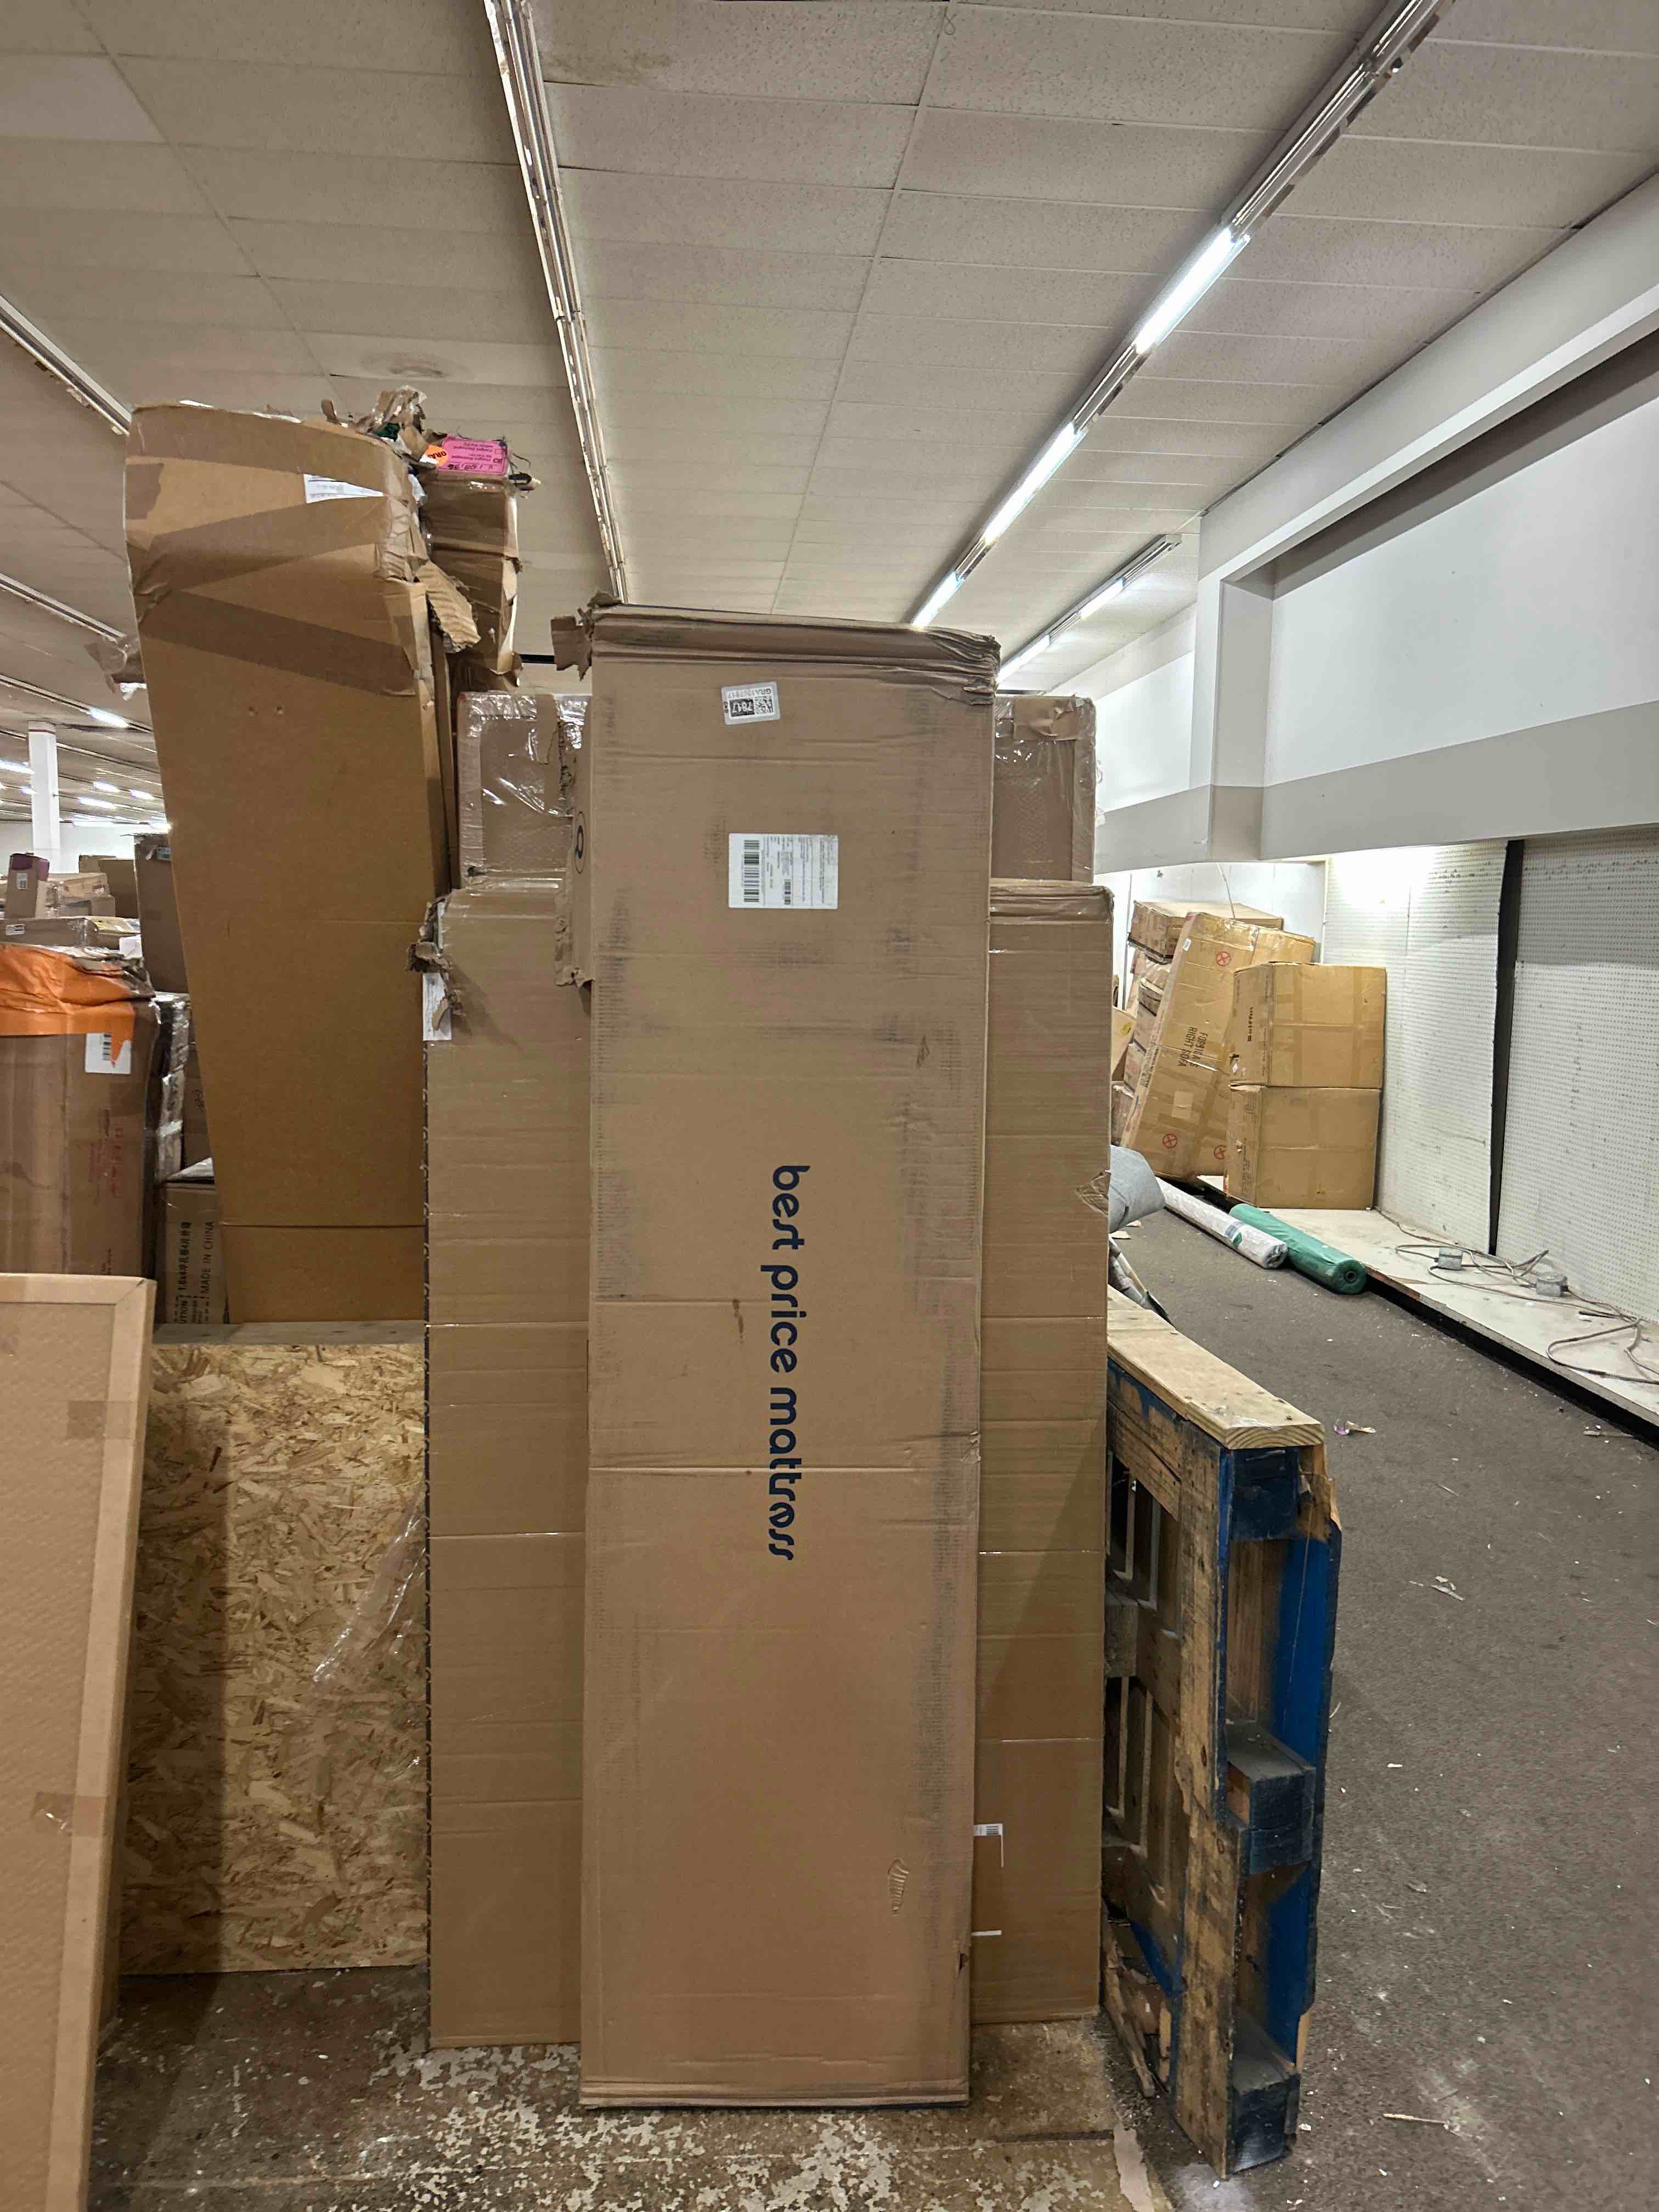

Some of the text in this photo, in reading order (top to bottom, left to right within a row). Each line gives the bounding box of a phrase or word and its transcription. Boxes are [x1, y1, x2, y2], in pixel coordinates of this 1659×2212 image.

[1184, 1027, 1198, 1048] RIGHT
[200, 1221, 215, 1294] MADE IN CHINA
[760, 1166, 811, 1561] best price mattress
